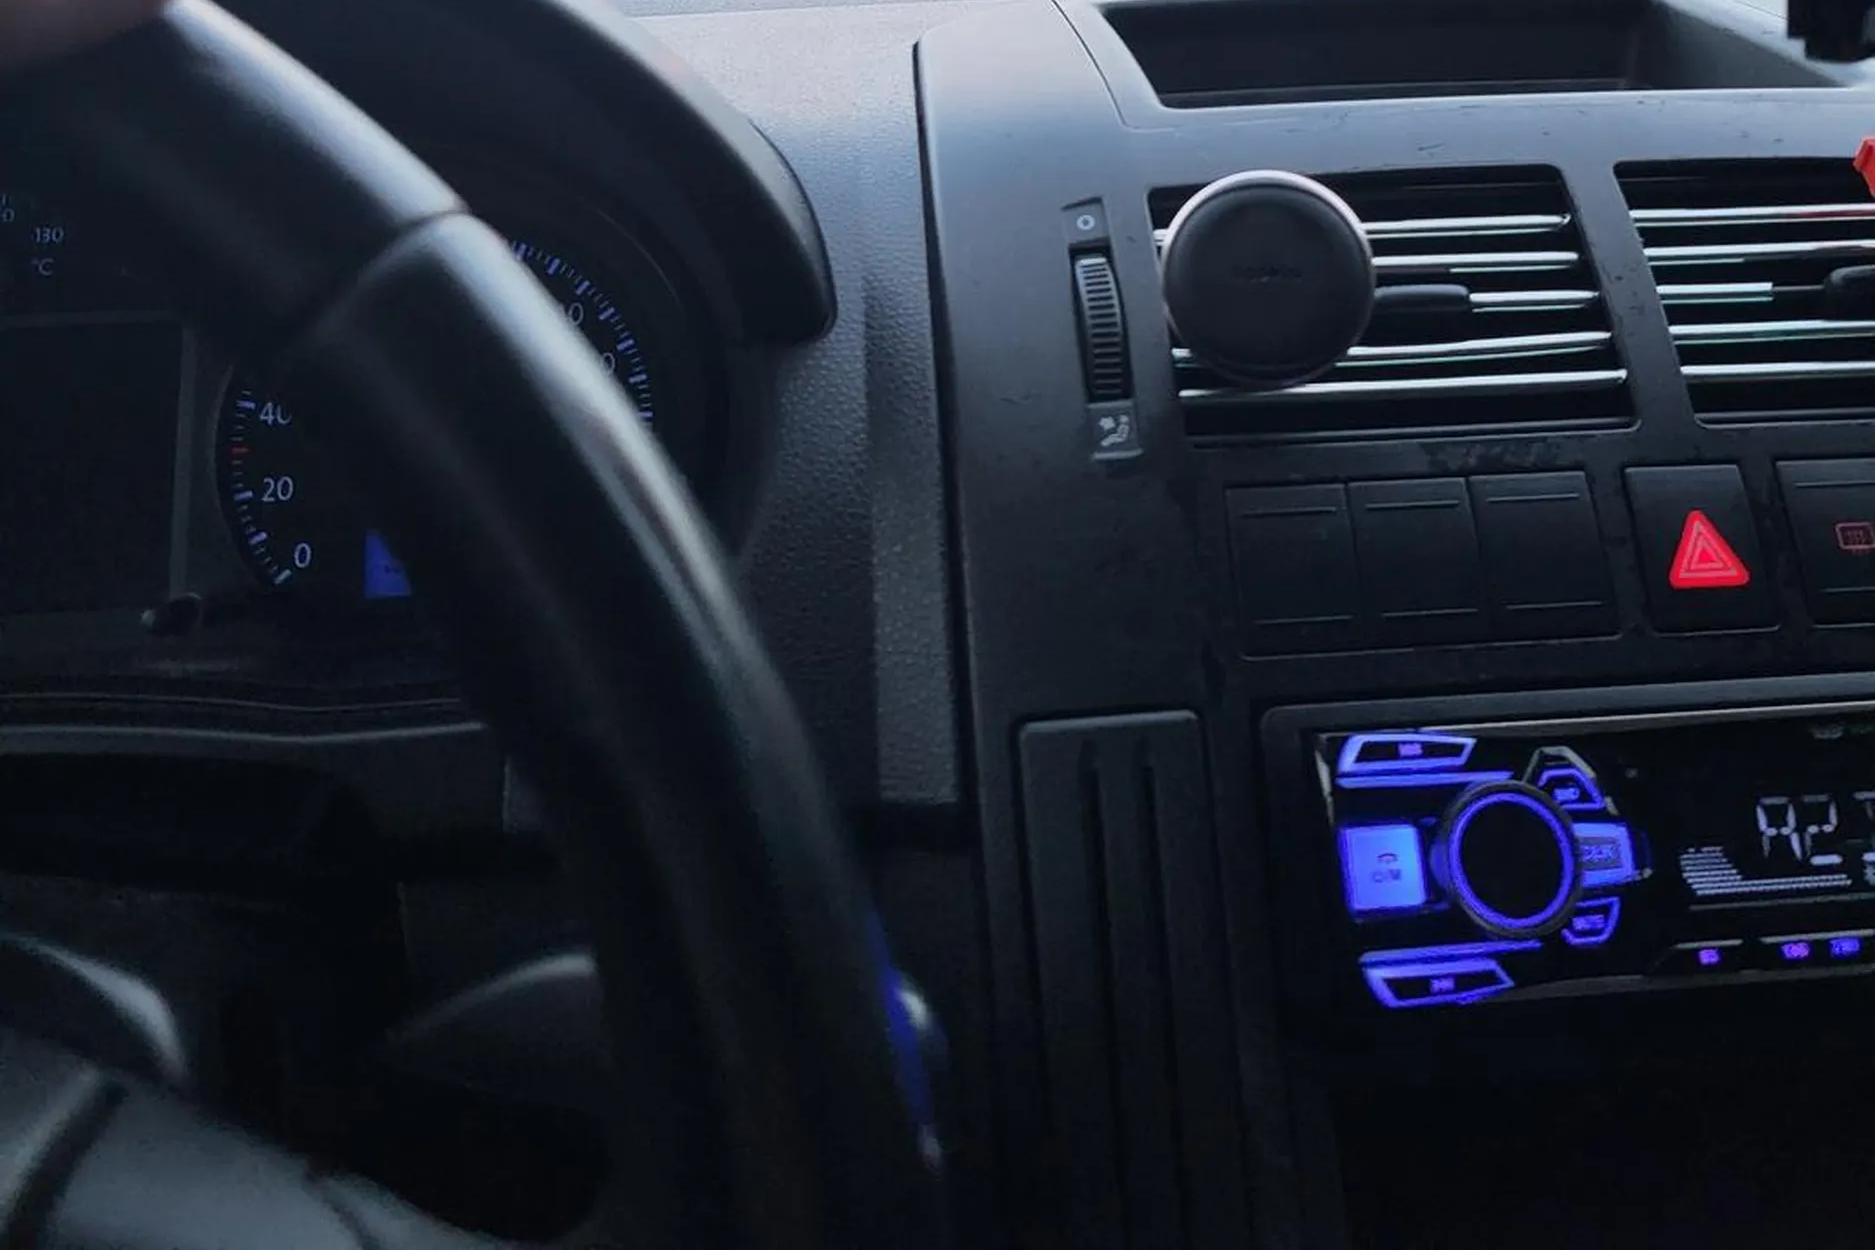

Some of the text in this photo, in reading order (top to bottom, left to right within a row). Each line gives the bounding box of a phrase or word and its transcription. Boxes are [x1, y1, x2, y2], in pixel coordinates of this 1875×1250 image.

[33, 226, 65, 245] 130
[261, 476, 295, 503] 20
[293, 541, 313, 570] 0
